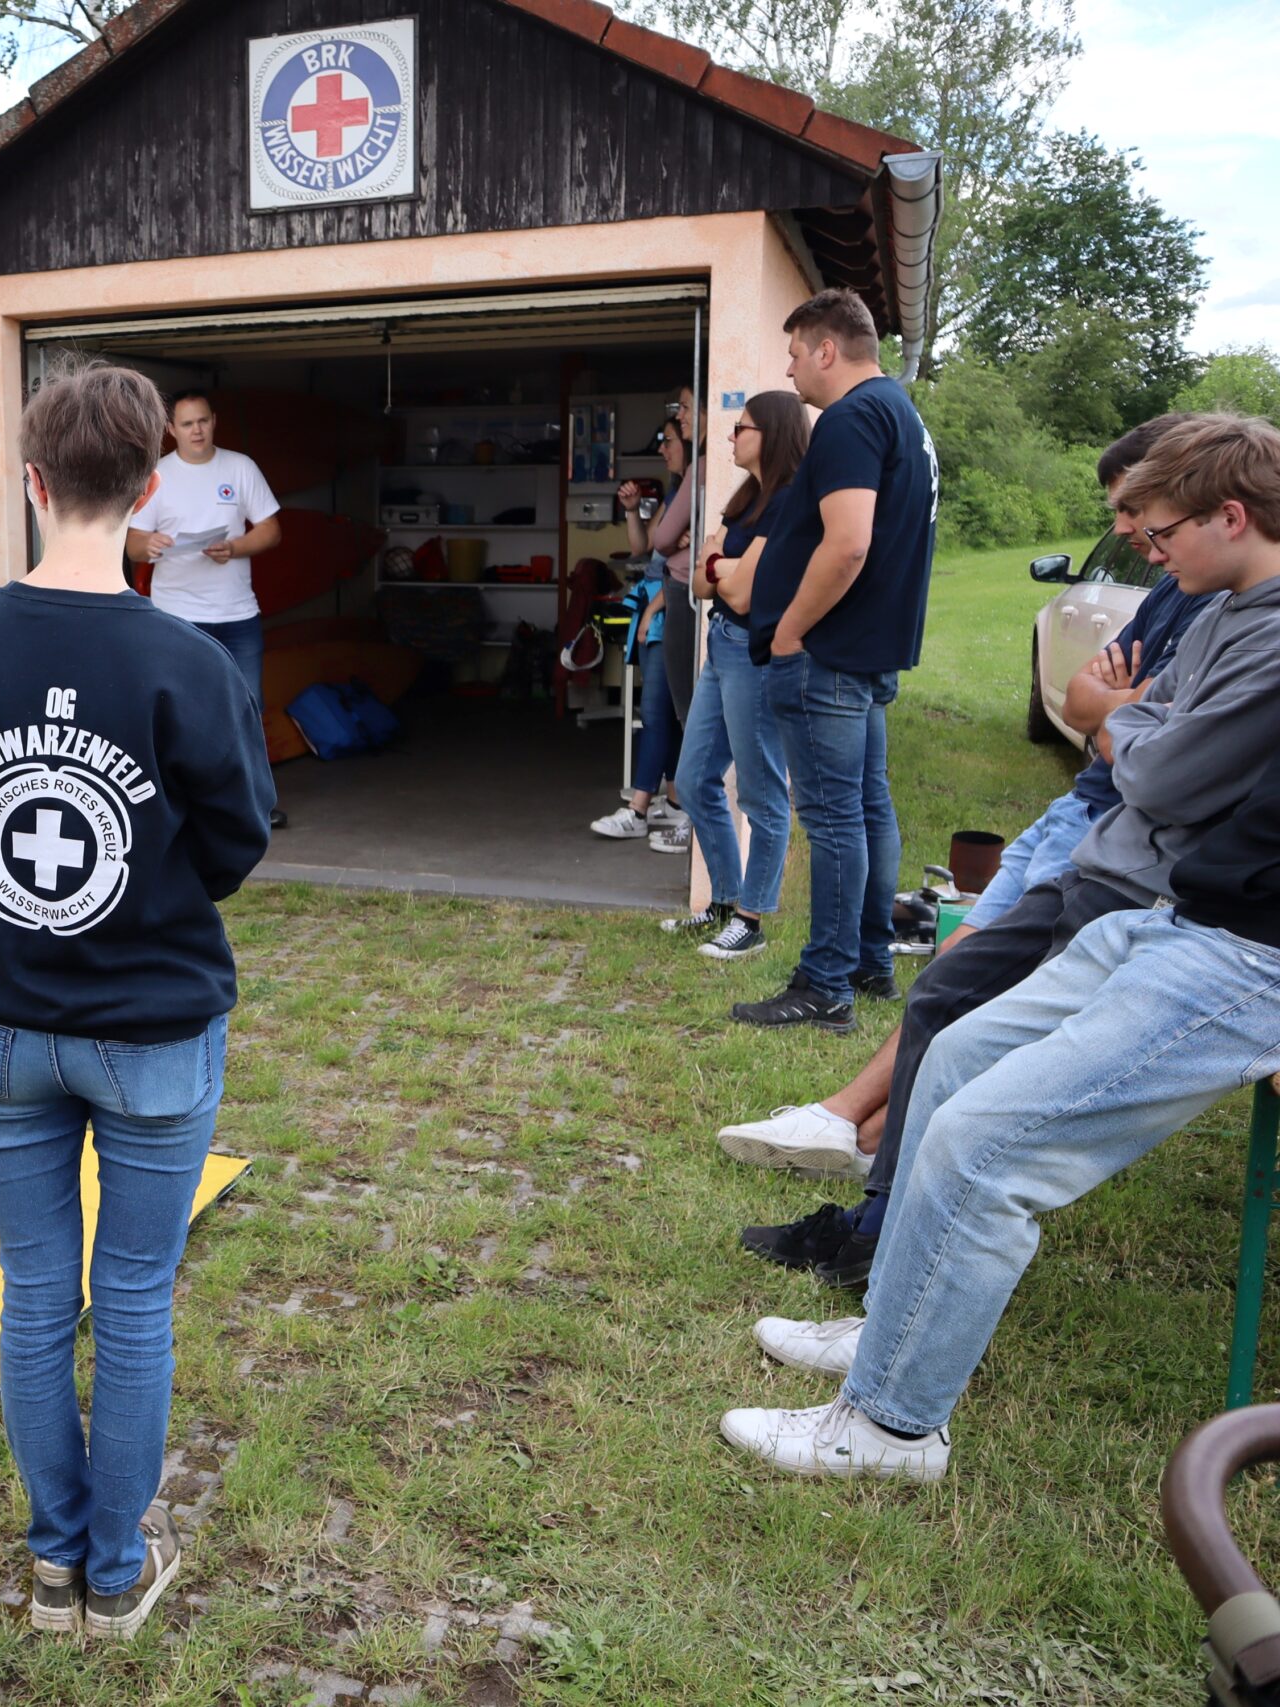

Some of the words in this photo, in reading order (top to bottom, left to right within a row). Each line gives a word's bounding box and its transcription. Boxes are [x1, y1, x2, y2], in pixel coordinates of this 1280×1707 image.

[302, 44, 355, 74] BRK
[264, 124, 327, 188] WASSER
[336, 115, 397, 184] WACHT
[45, 687, 77, 720] OG
[54, 779, 99, 811] ROTES
[95, 811, 117, 862] KREUZ
